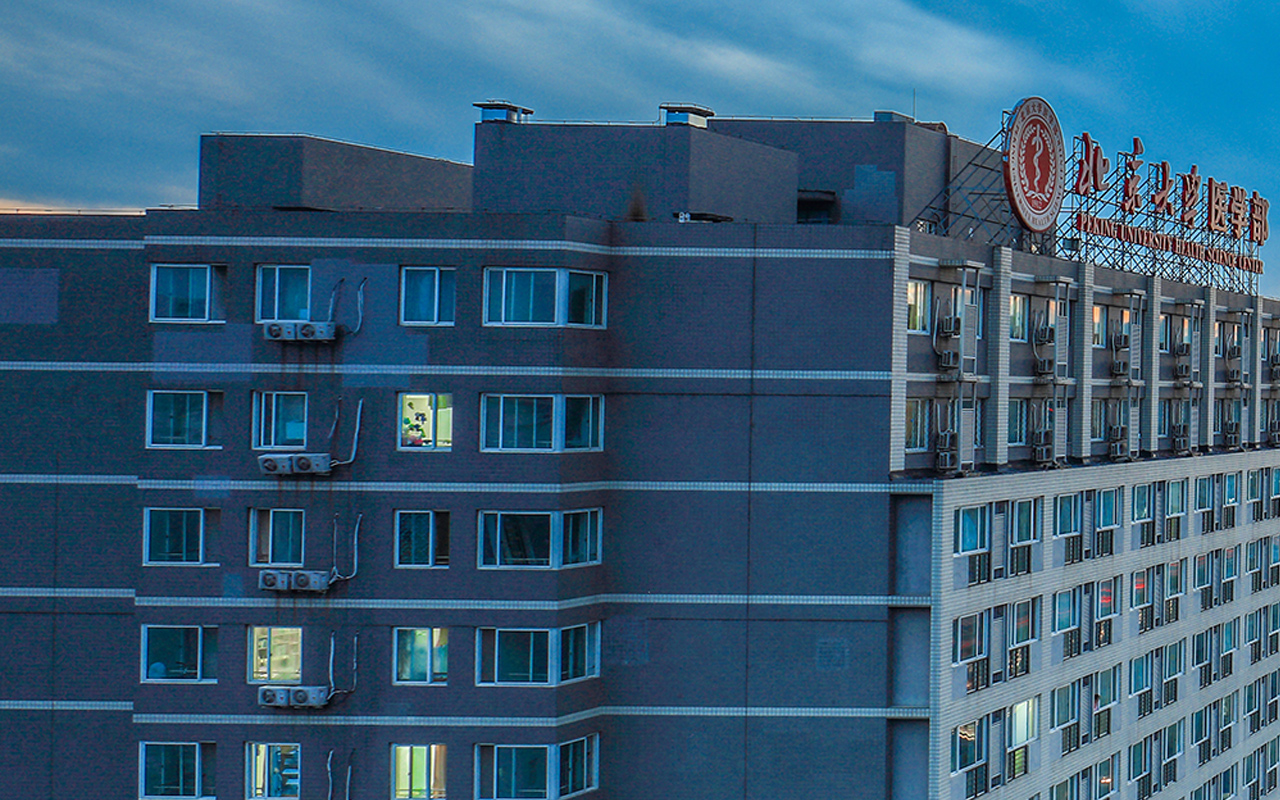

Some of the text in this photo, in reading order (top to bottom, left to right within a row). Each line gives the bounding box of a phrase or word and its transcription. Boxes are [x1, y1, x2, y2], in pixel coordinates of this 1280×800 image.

[1078, 214, 1263, 274] PEKING UNIVERSITY HEALTH SCIENCE CENTER
